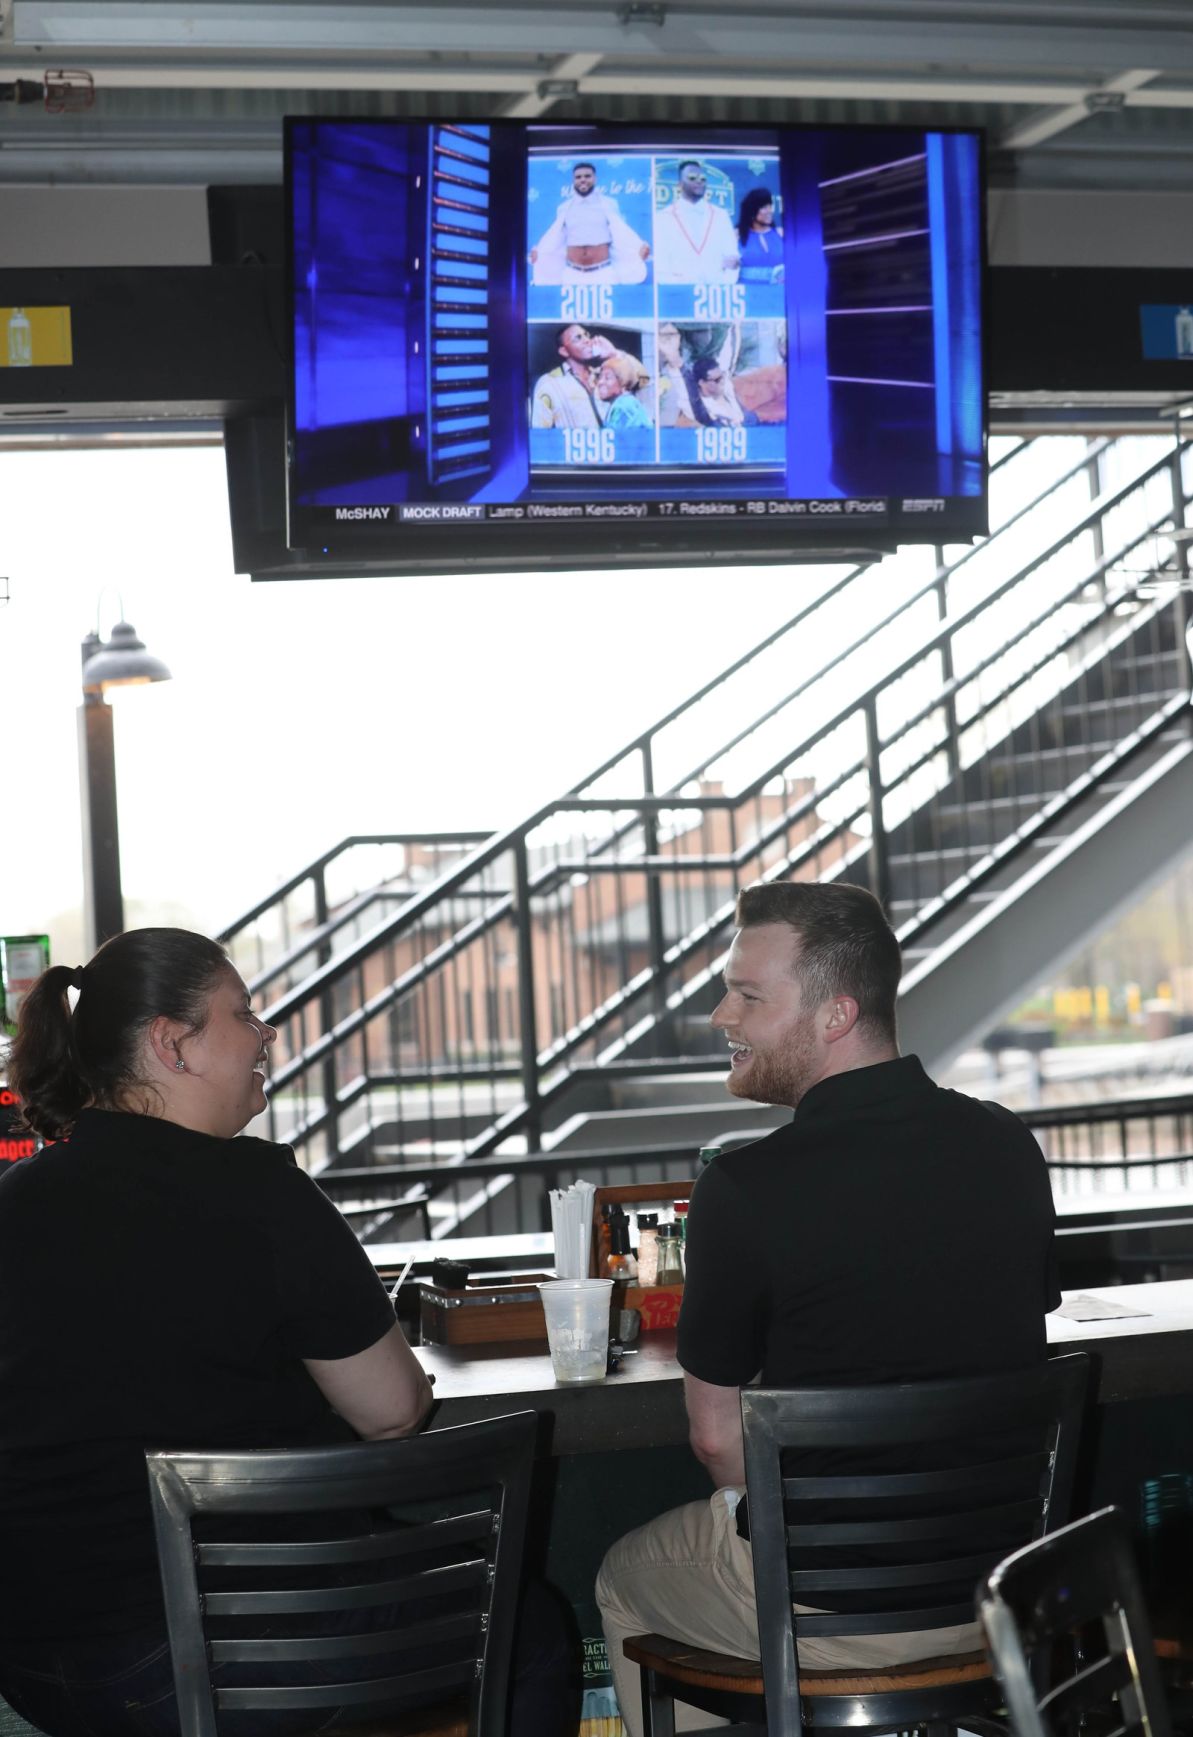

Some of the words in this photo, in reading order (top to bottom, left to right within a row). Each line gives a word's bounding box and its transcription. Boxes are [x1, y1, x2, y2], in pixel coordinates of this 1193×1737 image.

[561, 284, 613, 320] 2016
[694, 284, 746, 321] 2015
[563, 428, 615, 463] 1996
[696, 427, 747, 463] 1989
[336, 507, 390, 520] McSHAY
[403, 506, 441, 519] MOCK
[443, 506, 482, 518] DRAFT
[489, 504, 524, 519] Lamp
[527, 504, 583, 517] (Western
[585, 503, 648, 517] Kentucky)
[659, 502, 677, 514] 17.
[680, 502, 737, 515] Redskins
[747, 501, 765, 514] RB
[768, 501, 806, 514] Dalvin
[808, 500, 841, 513] Cook
[902, 499, 945, 512] ESPN
